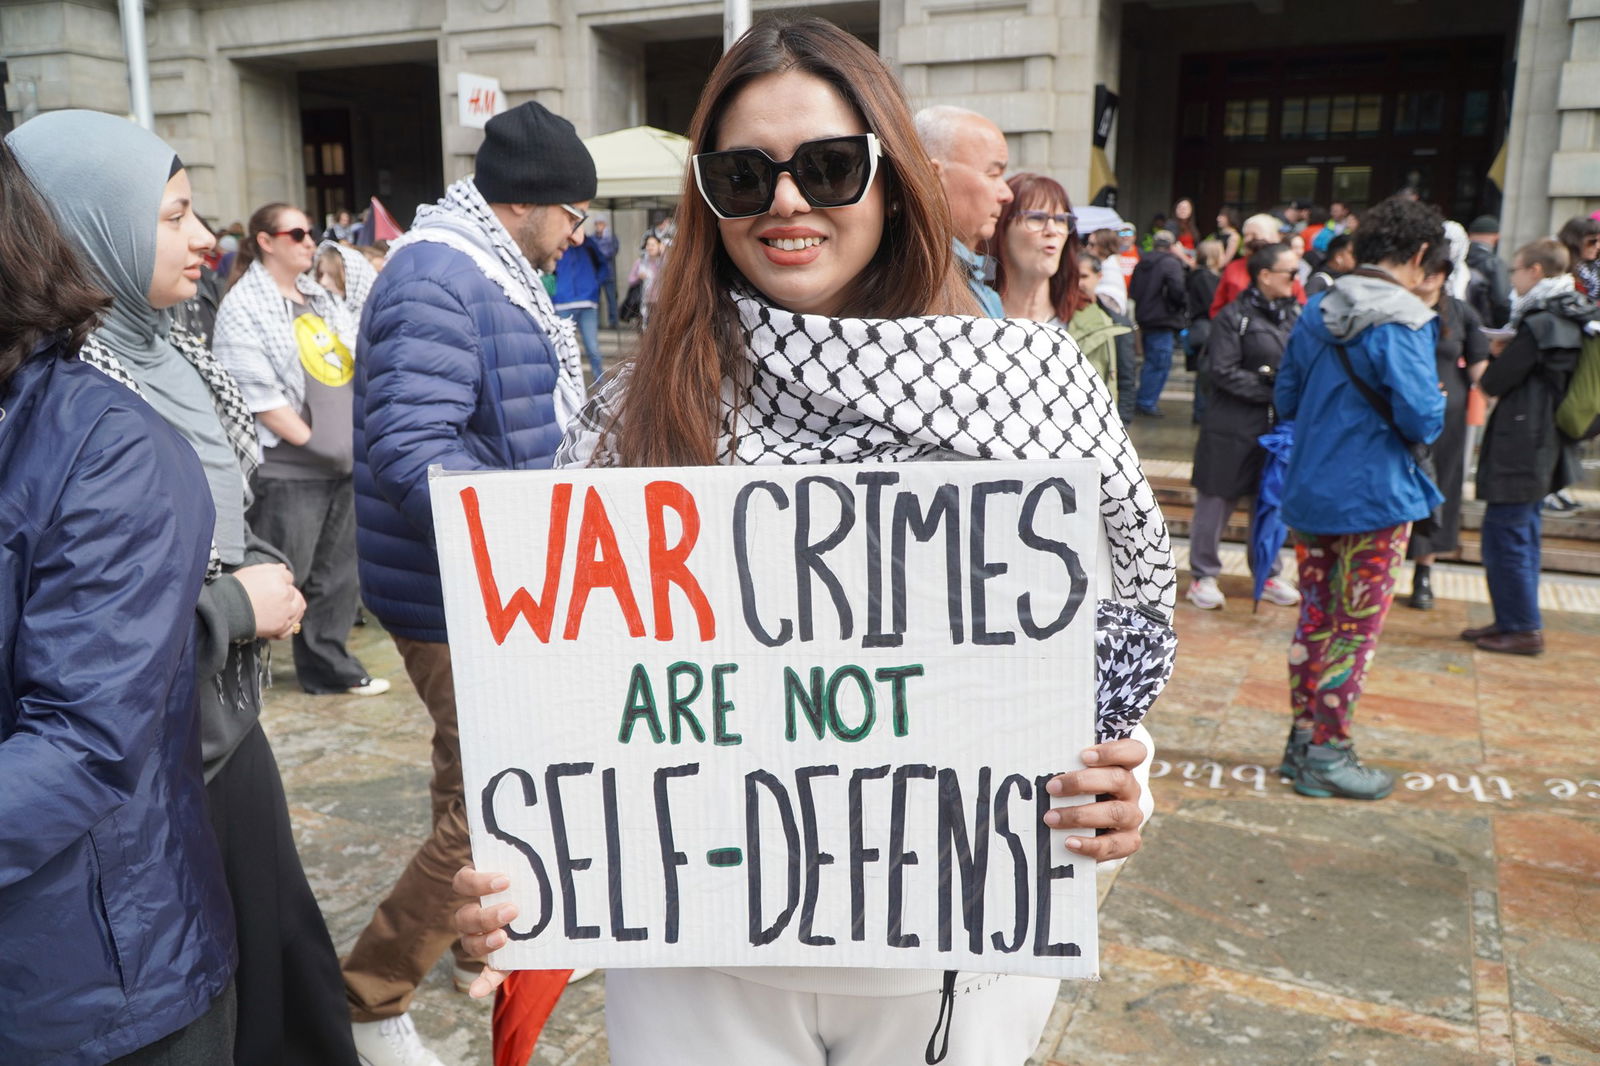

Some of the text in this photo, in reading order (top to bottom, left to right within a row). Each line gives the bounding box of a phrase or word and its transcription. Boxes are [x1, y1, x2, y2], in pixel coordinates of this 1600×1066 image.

[459, 471, 1089, 649] WAR CRIMES
[617, 661, 925, 746] ARE NOT
[1402, 771, 1514, 802] the
[481, 761, 1083, 958] SELF-DEFENSE
